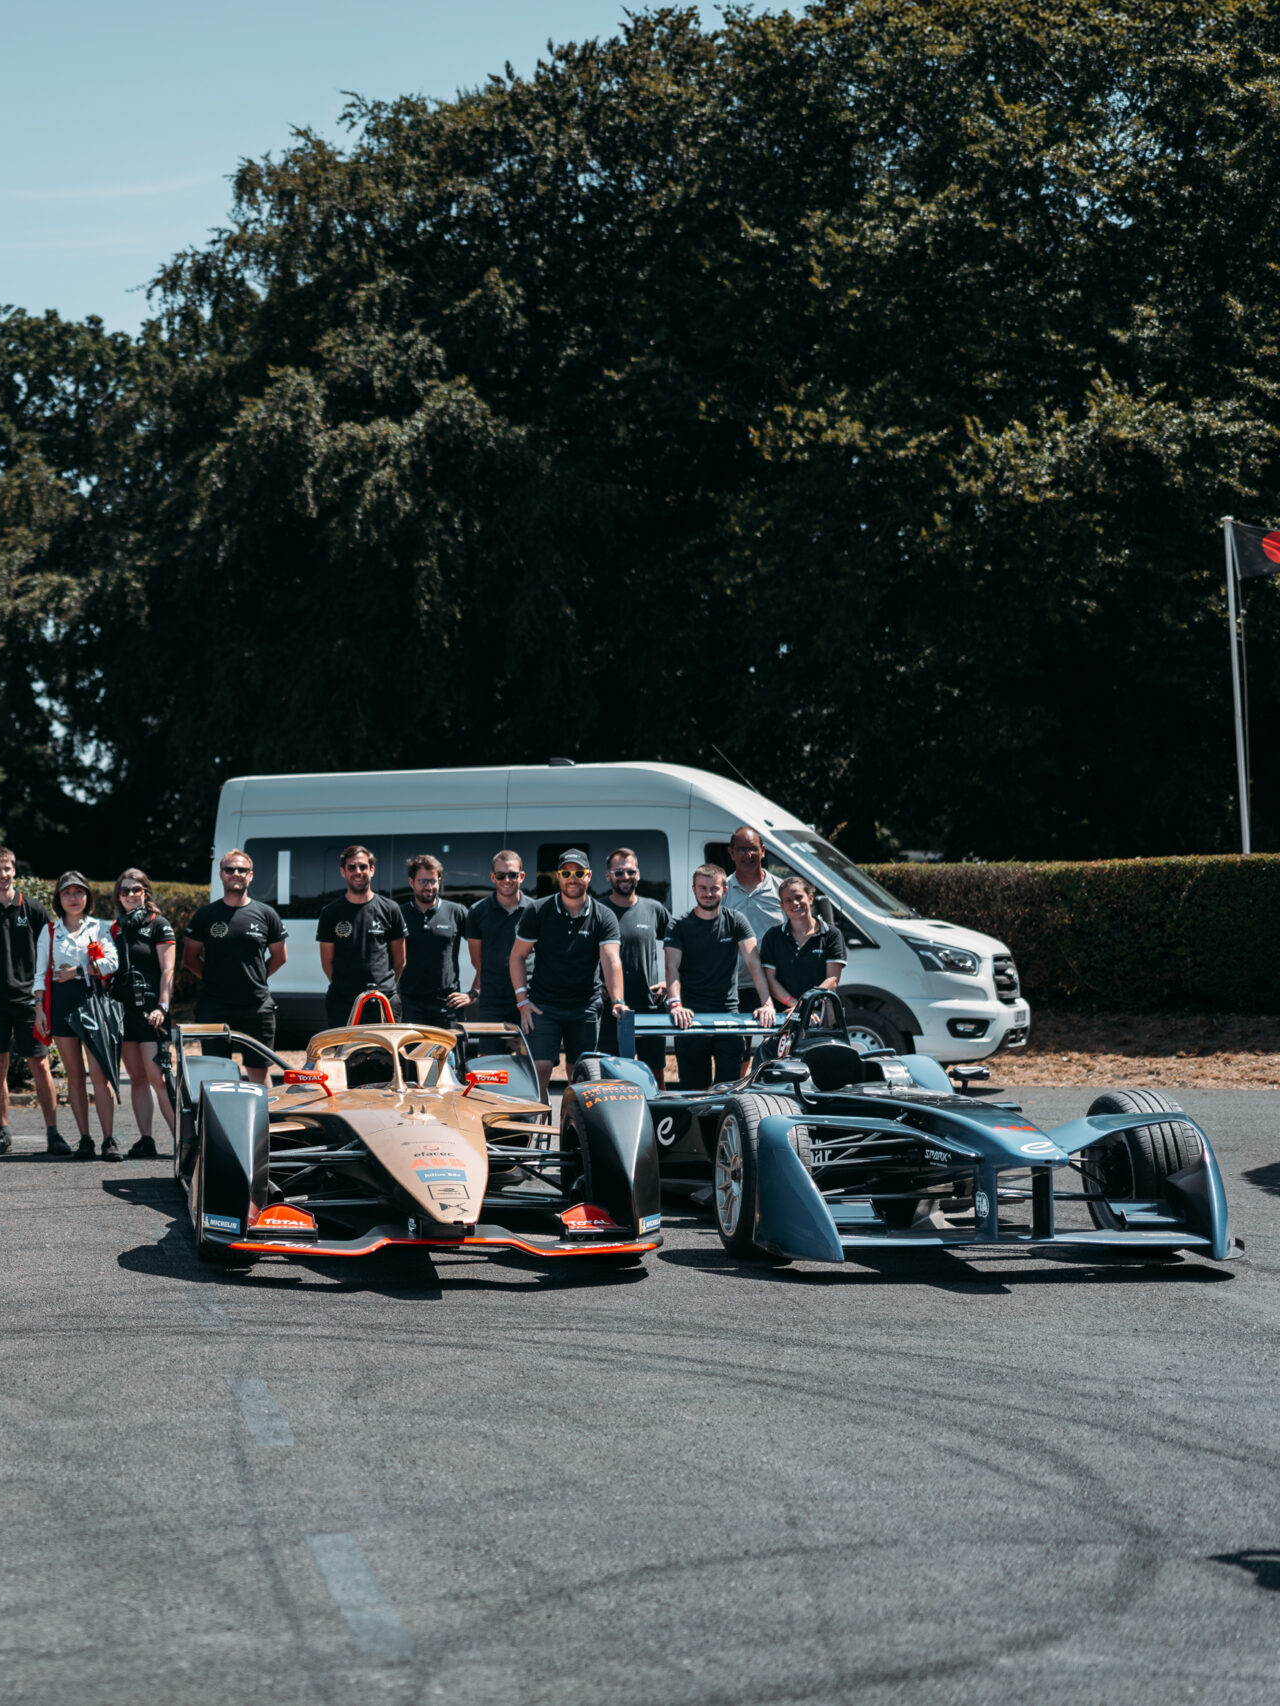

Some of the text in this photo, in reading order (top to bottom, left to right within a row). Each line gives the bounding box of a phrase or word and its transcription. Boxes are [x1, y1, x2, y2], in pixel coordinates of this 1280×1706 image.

[209, 1082, 263, 1097] 25
[410, 1158, 466, 1169] ABB
[209, 1218, 238, 1230] MICHELIN
[263, 1218, 308, 1226] TOTAL
[566, 1219, 611, 1227] TOTAL
